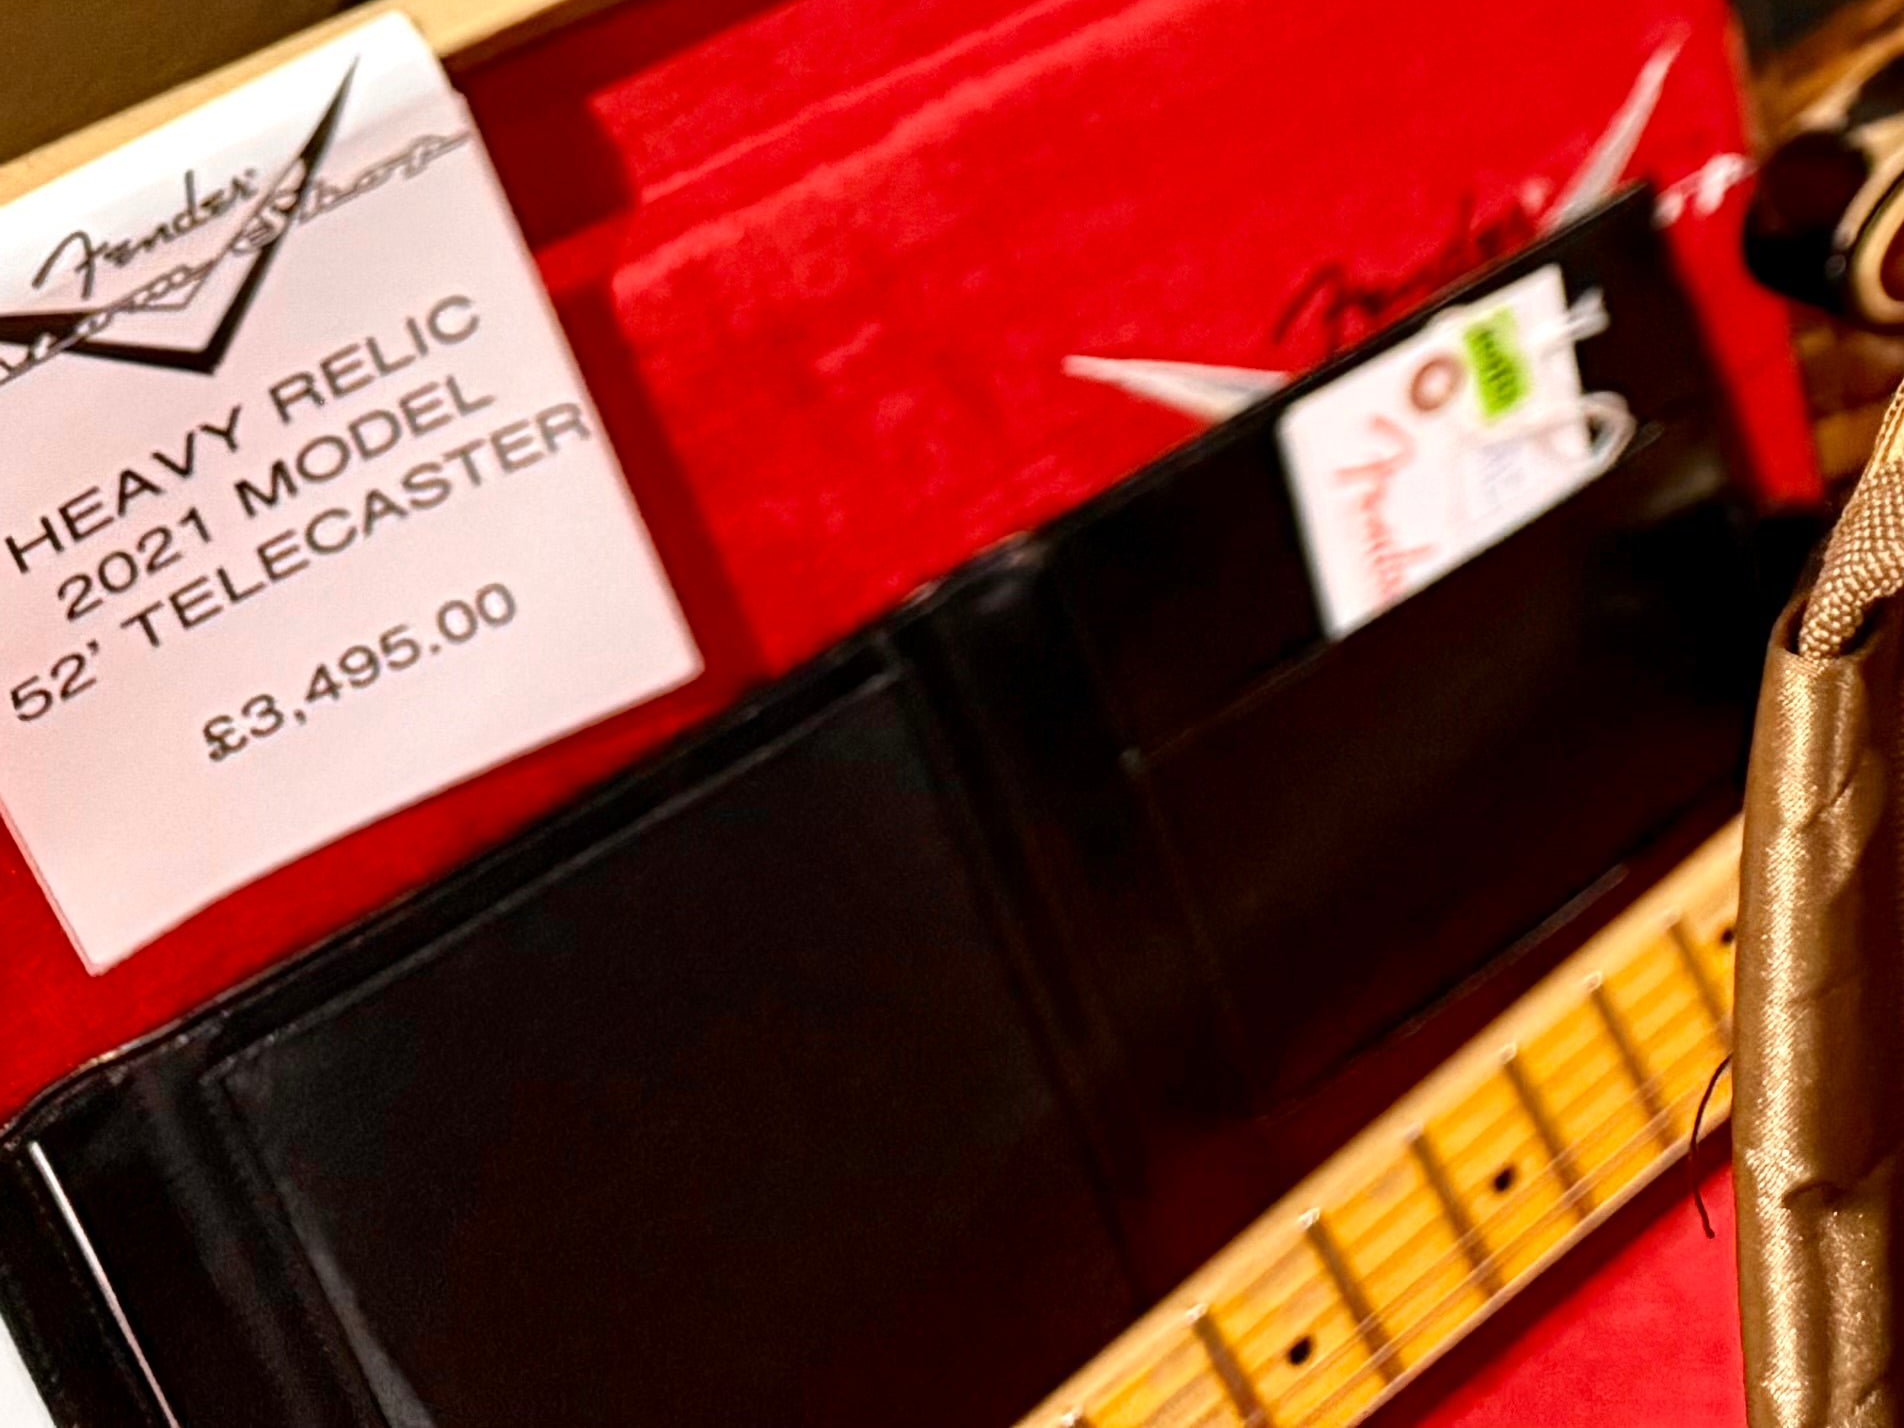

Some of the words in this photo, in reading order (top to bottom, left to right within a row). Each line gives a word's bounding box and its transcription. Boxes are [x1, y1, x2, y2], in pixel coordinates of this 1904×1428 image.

[30, 168, 257, 302] Fender
[4, 404, 243, 575] HEAVY
[268, 293, 481, 423] RELIC
[56, 506, 213, 622] 2021
[233, 373, 495, 519] MODEL
[119, 401, 592, 649] TELECASTER
[202, 581, 517, 762] £3,495.00
